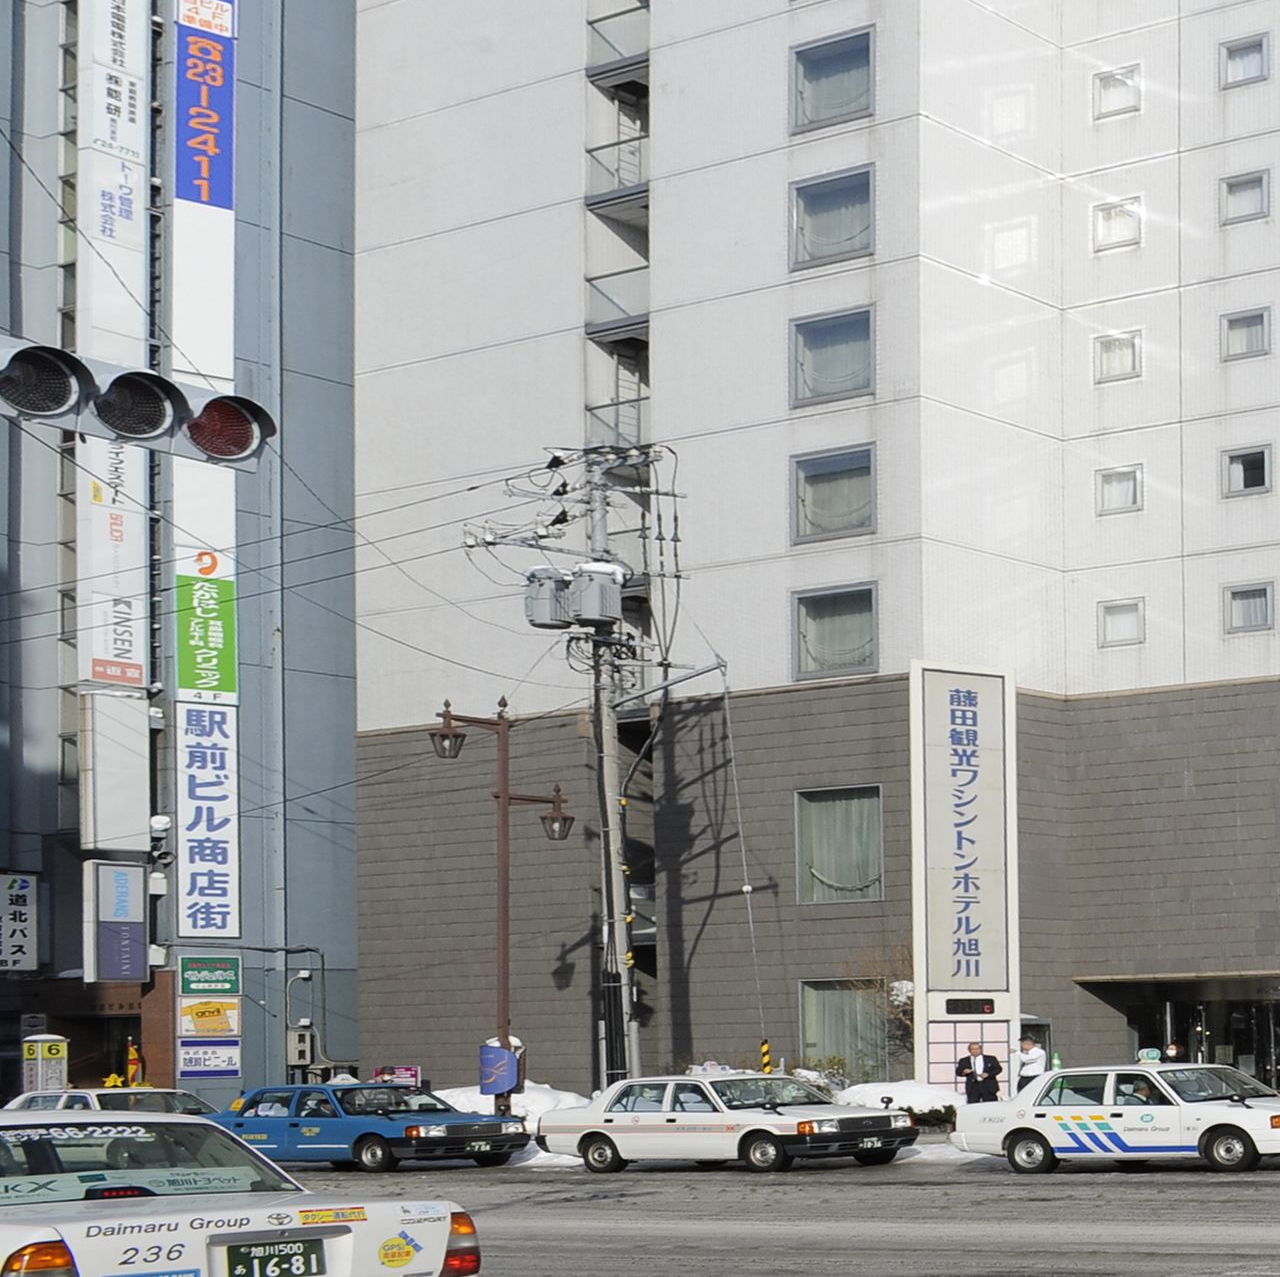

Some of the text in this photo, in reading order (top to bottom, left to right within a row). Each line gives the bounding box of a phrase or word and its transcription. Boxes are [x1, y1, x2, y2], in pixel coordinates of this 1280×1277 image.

[100, 190, 116, 239] 株式会社
[112, 598, 134, 661] KINSEN
[184, 709, 232, 931] 駅前ビル商店街
[948, 688, 982, 978] 藤田観光ワシントンホテル旭川
[113, 871, 130, 918] ADERANS
[8, 893, 29, 956] 道北バス
[27, 1044, 36, 1056] 6
[47, 1044, 61, 1056] 6
[51, 1126, 148, 1139] 66-2222
[86, 1216, 251, 1239] Daimaru Group
[118, 1243, 186, 1266] 236
[253, 1253, 317, 1277] 16-81
[234, 1264, 247, 1275] あ
